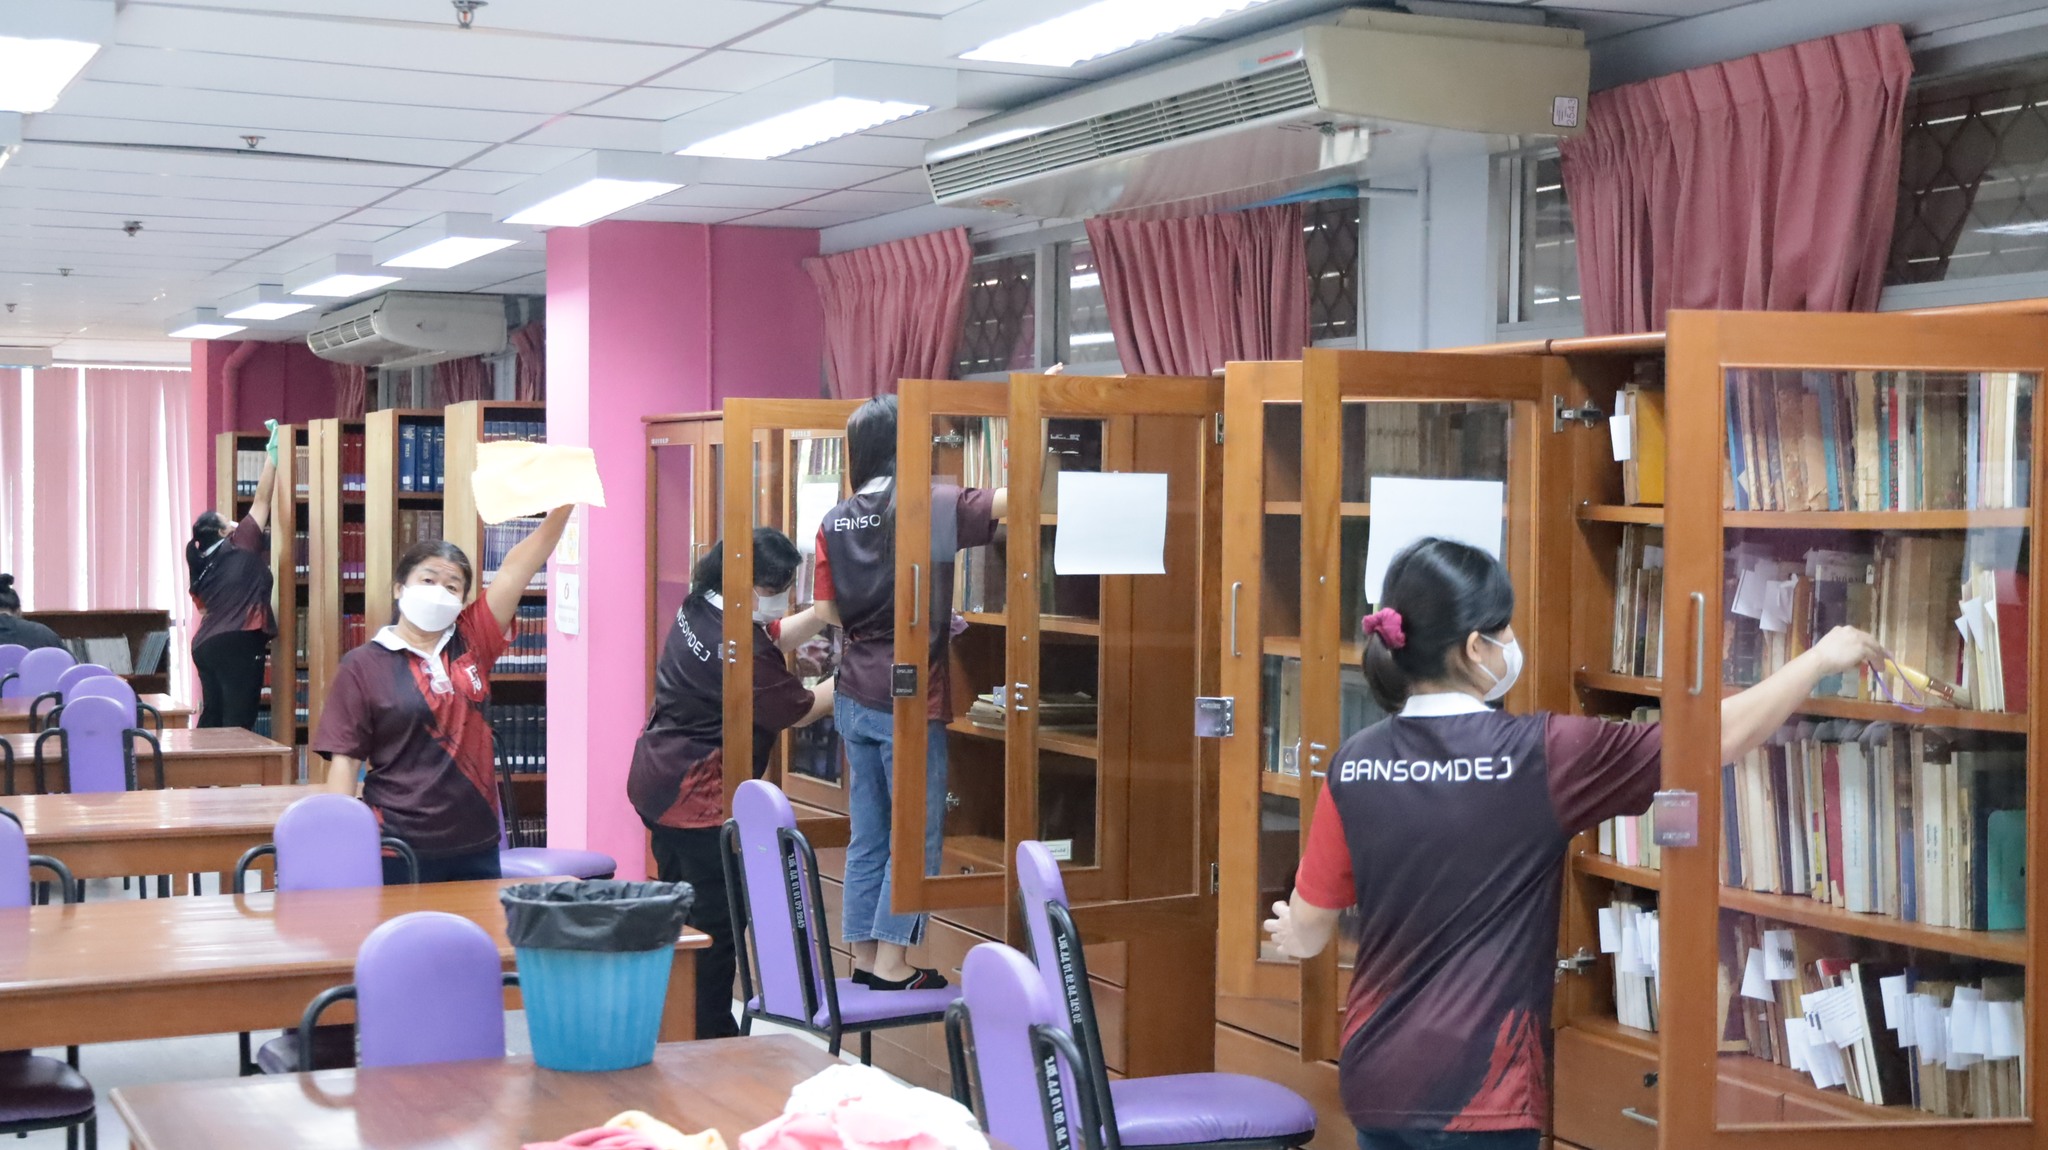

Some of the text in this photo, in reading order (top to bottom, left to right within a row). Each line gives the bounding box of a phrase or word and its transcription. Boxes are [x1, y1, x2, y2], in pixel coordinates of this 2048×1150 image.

[834, 514, 881, 531] BANSO
[676, 605, 711, 662] NSOMDEJ
[1340, 756, 1513, 782] BANSOMDEJ
